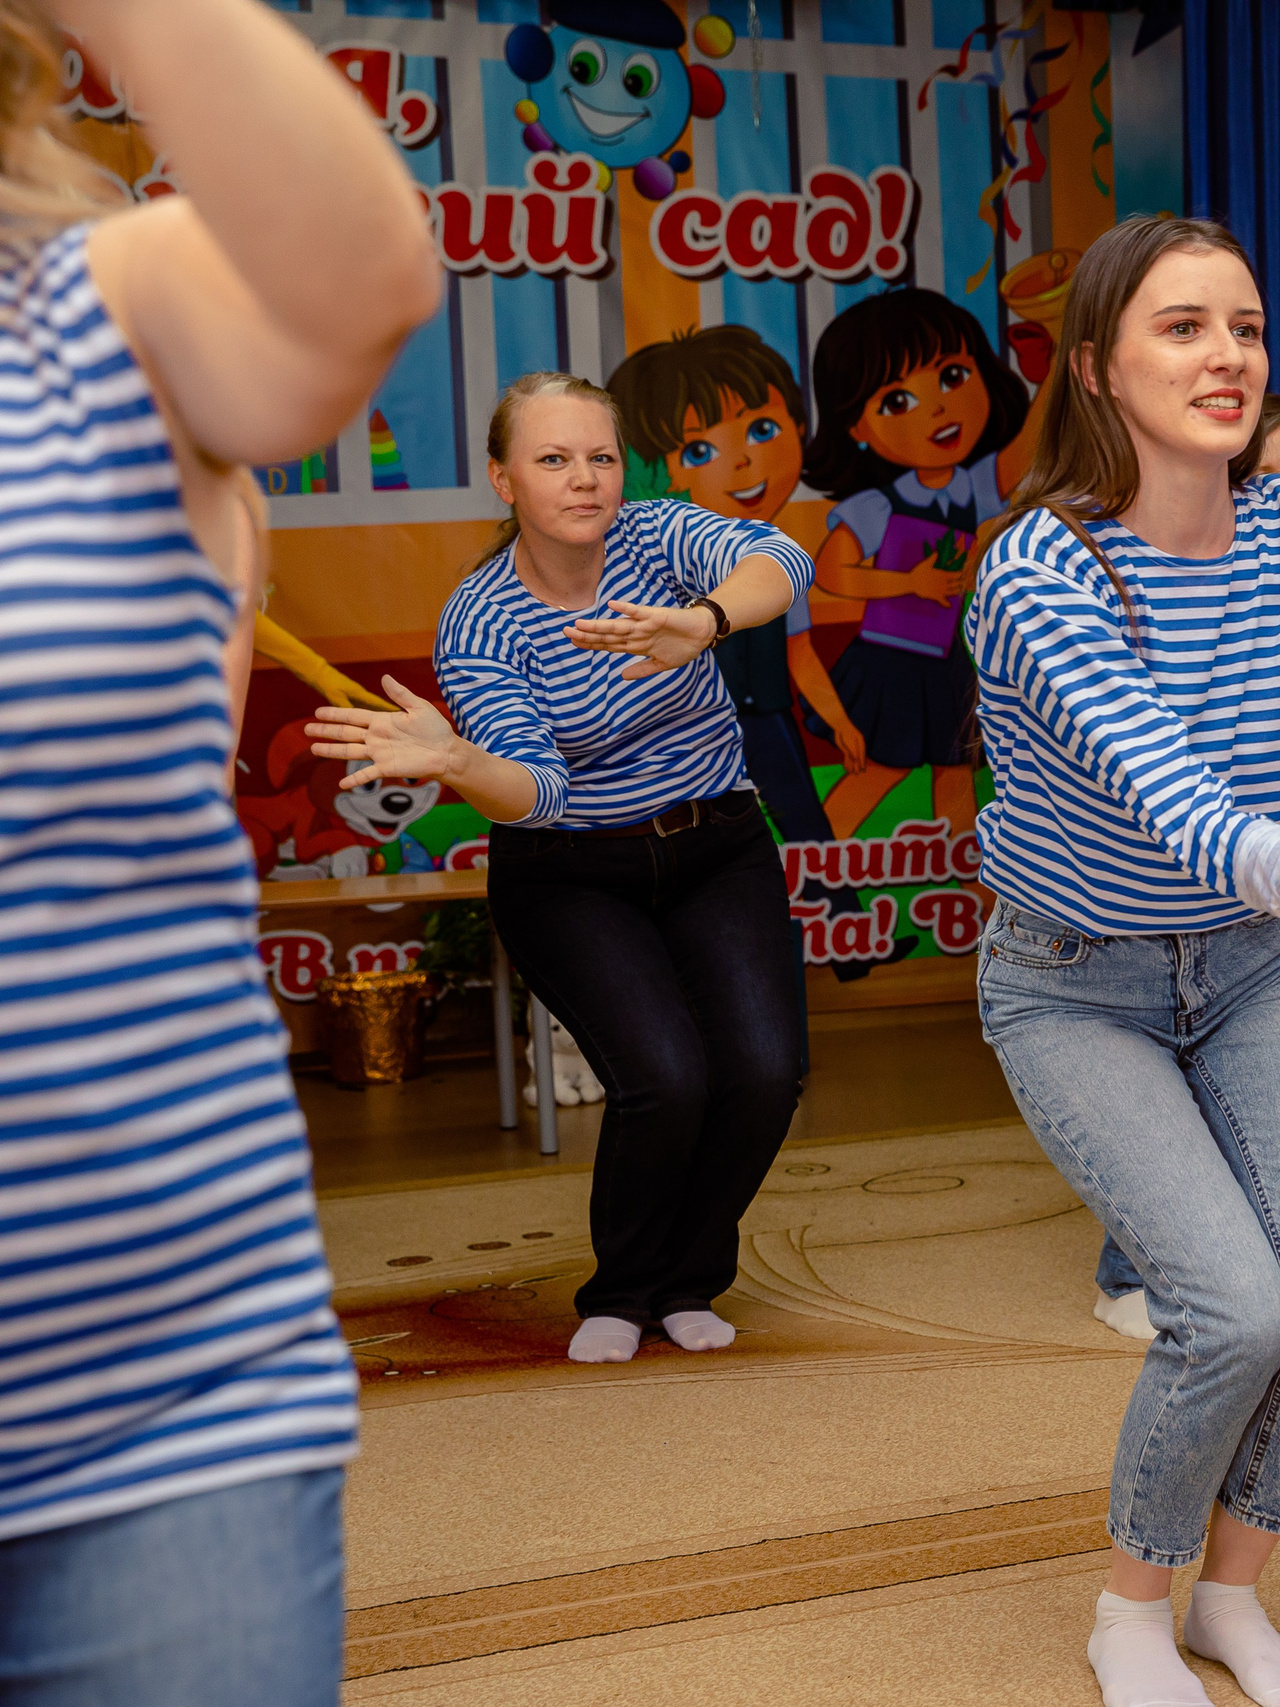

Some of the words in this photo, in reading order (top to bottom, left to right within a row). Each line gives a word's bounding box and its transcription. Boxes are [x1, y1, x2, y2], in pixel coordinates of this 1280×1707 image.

[412, 154, 608, 274] ий
[652, 167, 912, 278] сад!
[910, 890, 983, 952] В
